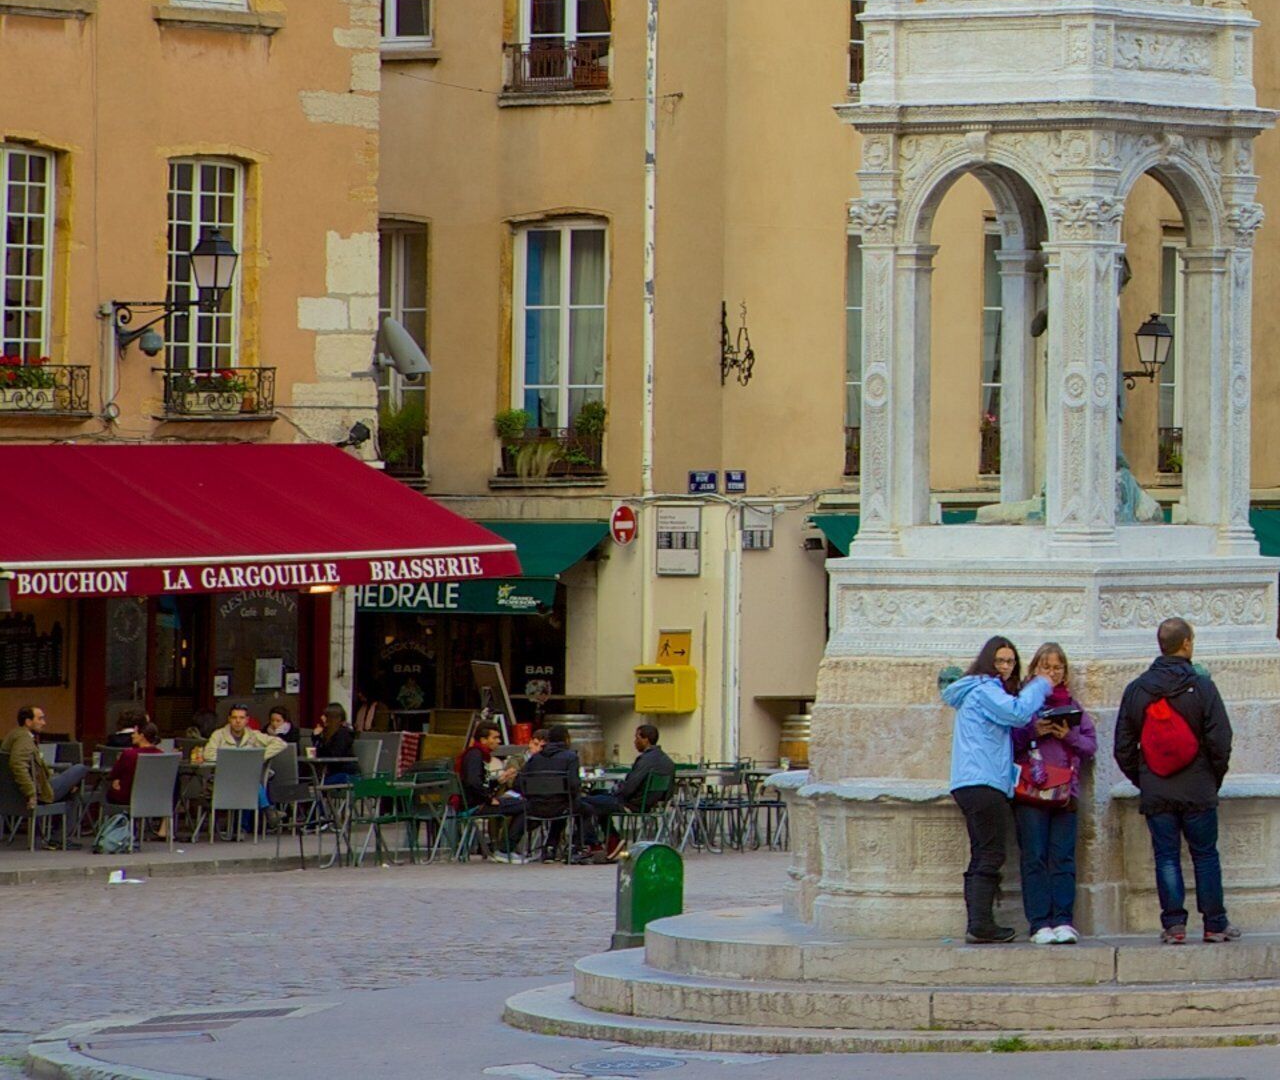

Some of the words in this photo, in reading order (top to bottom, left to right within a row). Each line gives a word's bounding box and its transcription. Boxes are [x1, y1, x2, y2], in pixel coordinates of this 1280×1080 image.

[17, 571, 128, 595] BOUCHON
[163, 568, 192, 590] LA
[201, 563, 340, 589] GARGOUILLE
[369, 556, 483, 580] BRASSERIE
[219, 588, 297, 618] RESTAURANT
[393, 664, 421, 673] BAR
[525, 665, 553, 675] BAR
